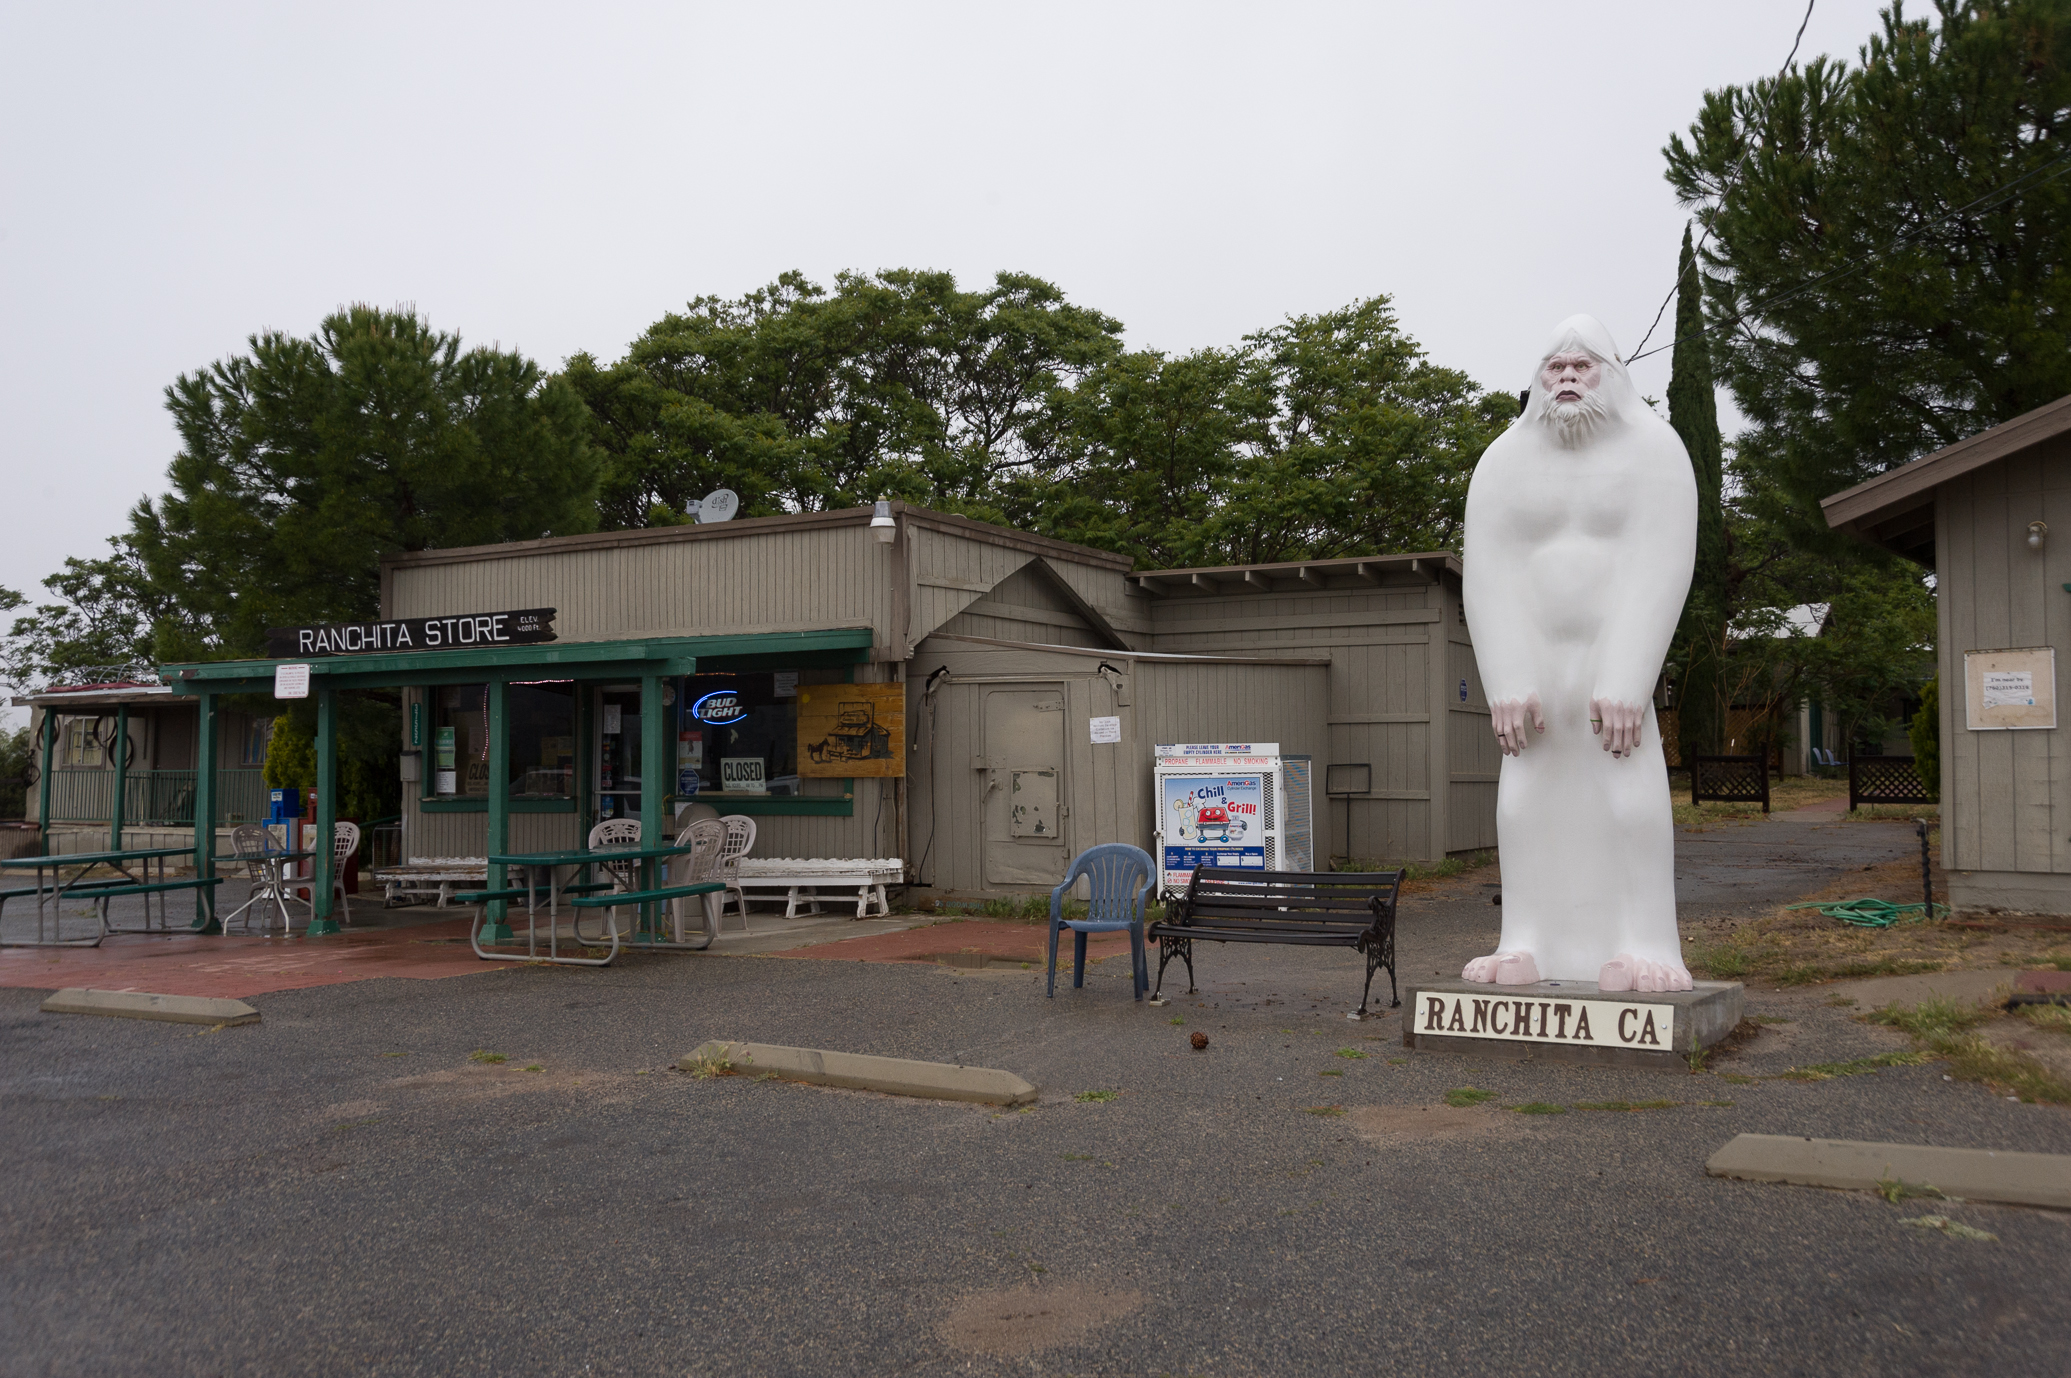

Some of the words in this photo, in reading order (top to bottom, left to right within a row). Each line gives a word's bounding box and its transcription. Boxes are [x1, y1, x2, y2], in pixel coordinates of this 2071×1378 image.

[299, 624, 413, 653] RANCHITA
[425, 614, 510, 646] STORE
[705, 697, 737, 709] BUD
[699, 706, 743, 719] LIGHT
[1244, 757, 1269, 765] SMOKING
[469, 763, 490, 780] CLOS
[724, 761, 762, 782] CLOSED
[1197, 785, 1225, 799] Chill
[1221, 797, 1227, 805] &
[1227, 801, 1257, 816] Grill!
[1423, 996, 1595, 1040] RANCHITA
[1618, 1007, 1660, 1045] CA
